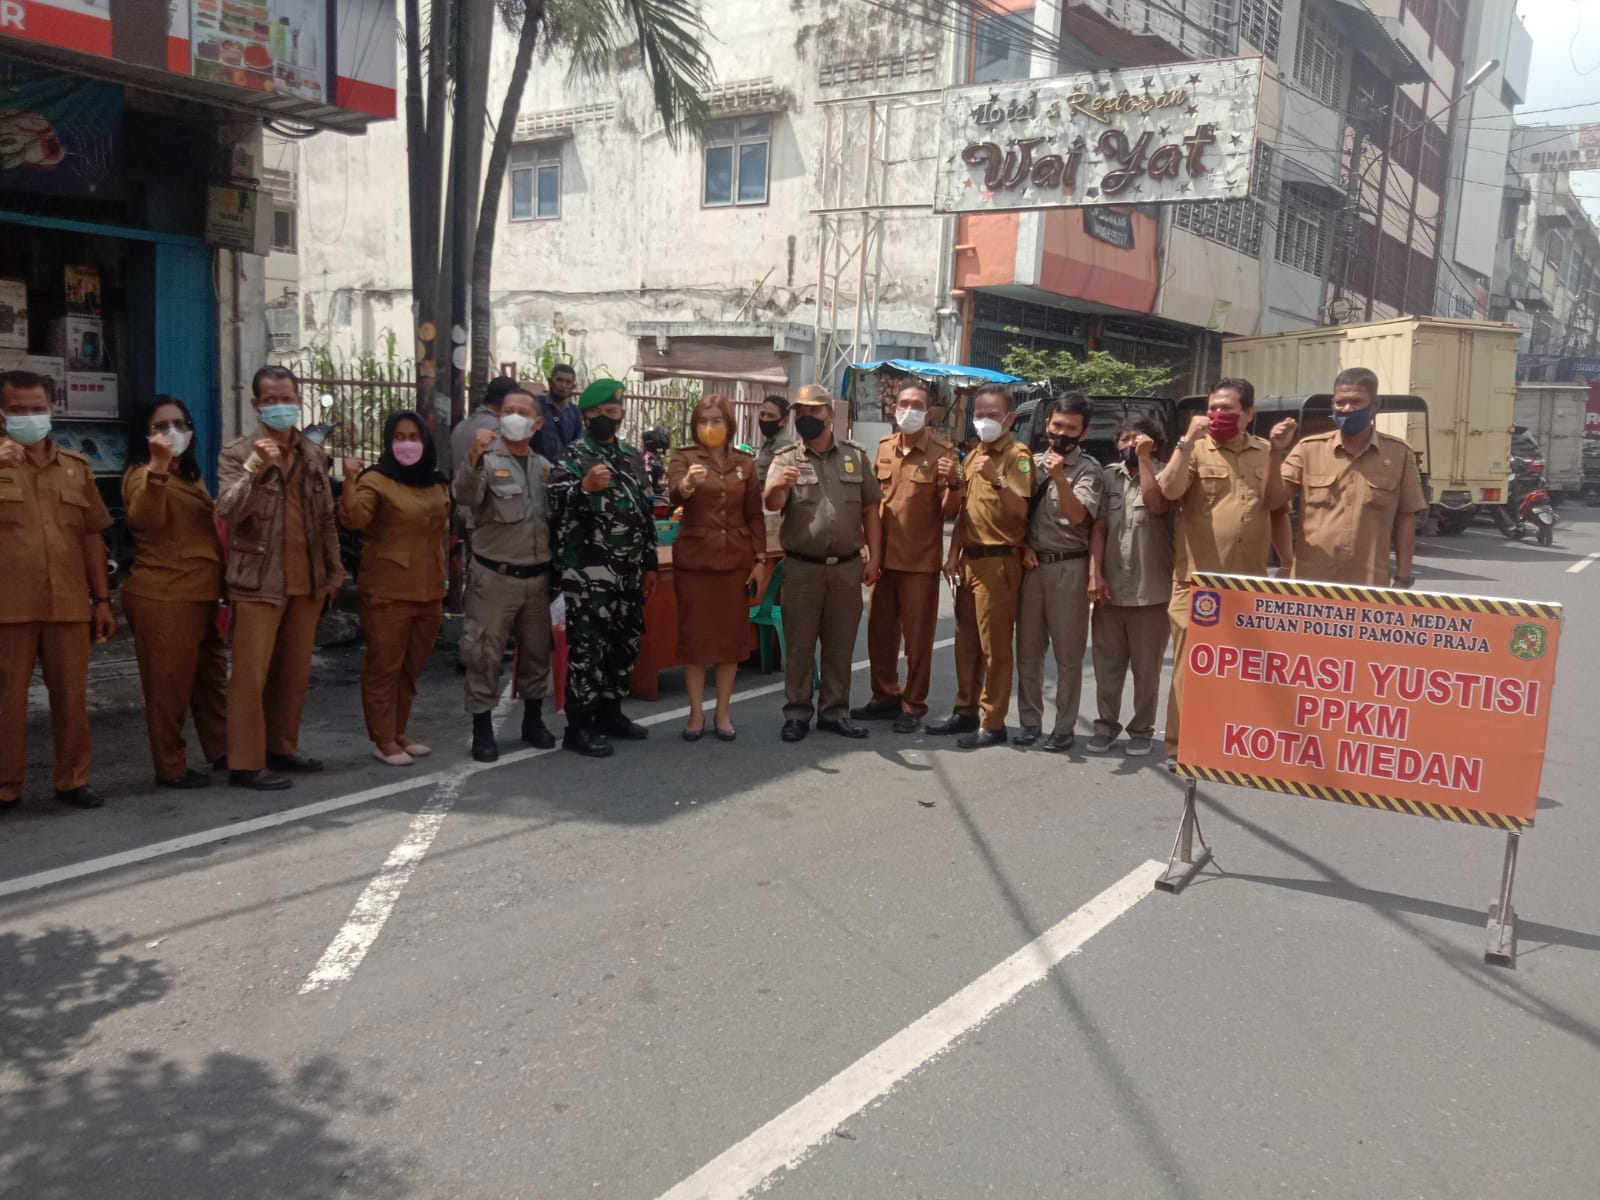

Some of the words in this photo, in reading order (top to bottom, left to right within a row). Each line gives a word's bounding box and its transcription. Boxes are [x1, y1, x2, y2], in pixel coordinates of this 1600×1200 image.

[975, 95, 1037, 125] Hotel
[1066, 89, 1187, 125] Restoran
[960, 137, 1084, 191] Wai
[1096, 123, 1217, 194] Yat
[1235, 614, 1298, 633] SATUAN
[1302, 621, 1355, 639] POLISI
[1358, 626, 1428, 645] PAMONG
[1433, 632, 1490, 652] PRAJA
[1254, 599, 1355, 621] PEMERINTAH
[1361, 608, 1405, 627] KOTA
[1411, 614, 1472, 633] MEDAN
[1189, 643, 1355, 692] OPERASI
[1368, 663, 1540, 716] YUSTISI
[1296, 695, 1409, 741] PPKM
[1223, 723, 1325, 769] KOTA
[1336, 740, 1482, 793] MEDAN
